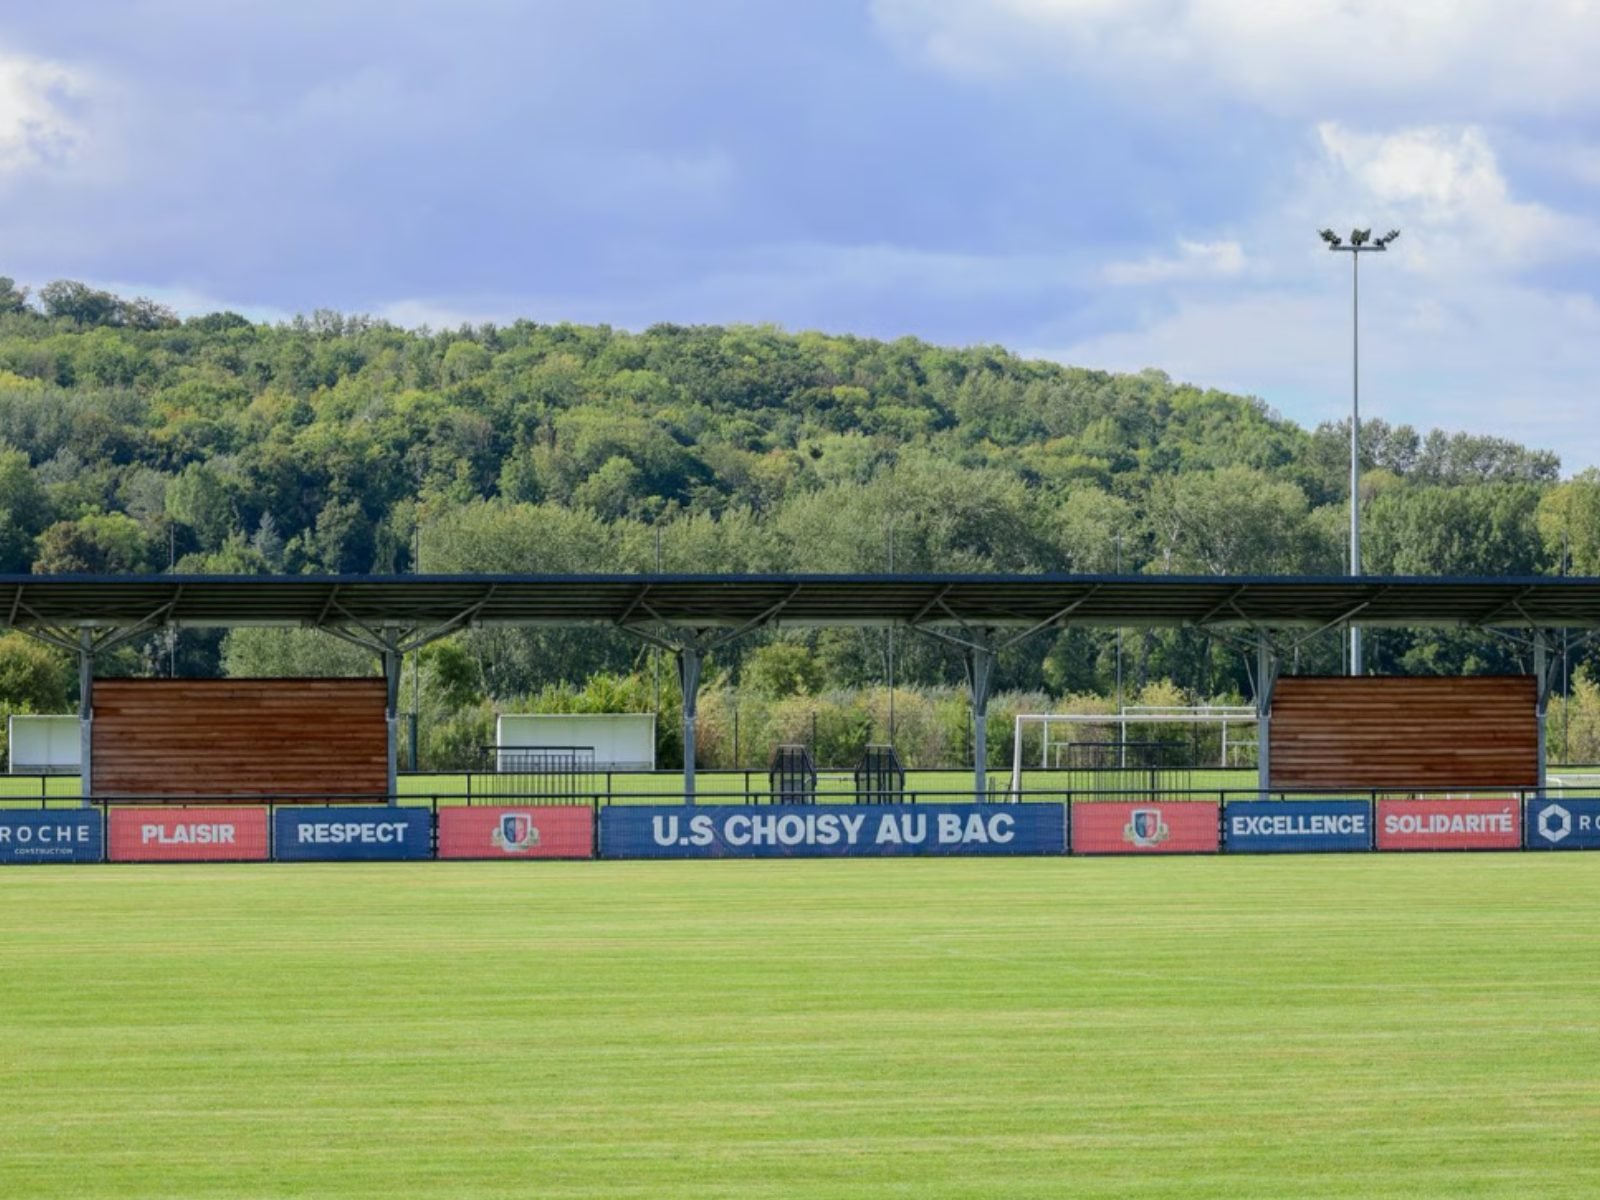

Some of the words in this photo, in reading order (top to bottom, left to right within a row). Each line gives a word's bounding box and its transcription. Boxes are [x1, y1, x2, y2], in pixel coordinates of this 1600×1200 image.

[653, 815, 714, 846] U.S
[724, 814, 865, 845] CHOISY
[875, 813, 927, 844] AU
[938, 813, 1015, 844] BAC
[1232, 815, 1365, 835] EXCELLENCE
[1385, 807, 1513, 834] SOLIDARITÉ
[0, 825, 90, 842] ROCHE
[141, 824, 235, 844] PLAISIR
[297, 822, 408, 843] RESPECT
[14, 847, 73, 855] CONSTRUCTION
